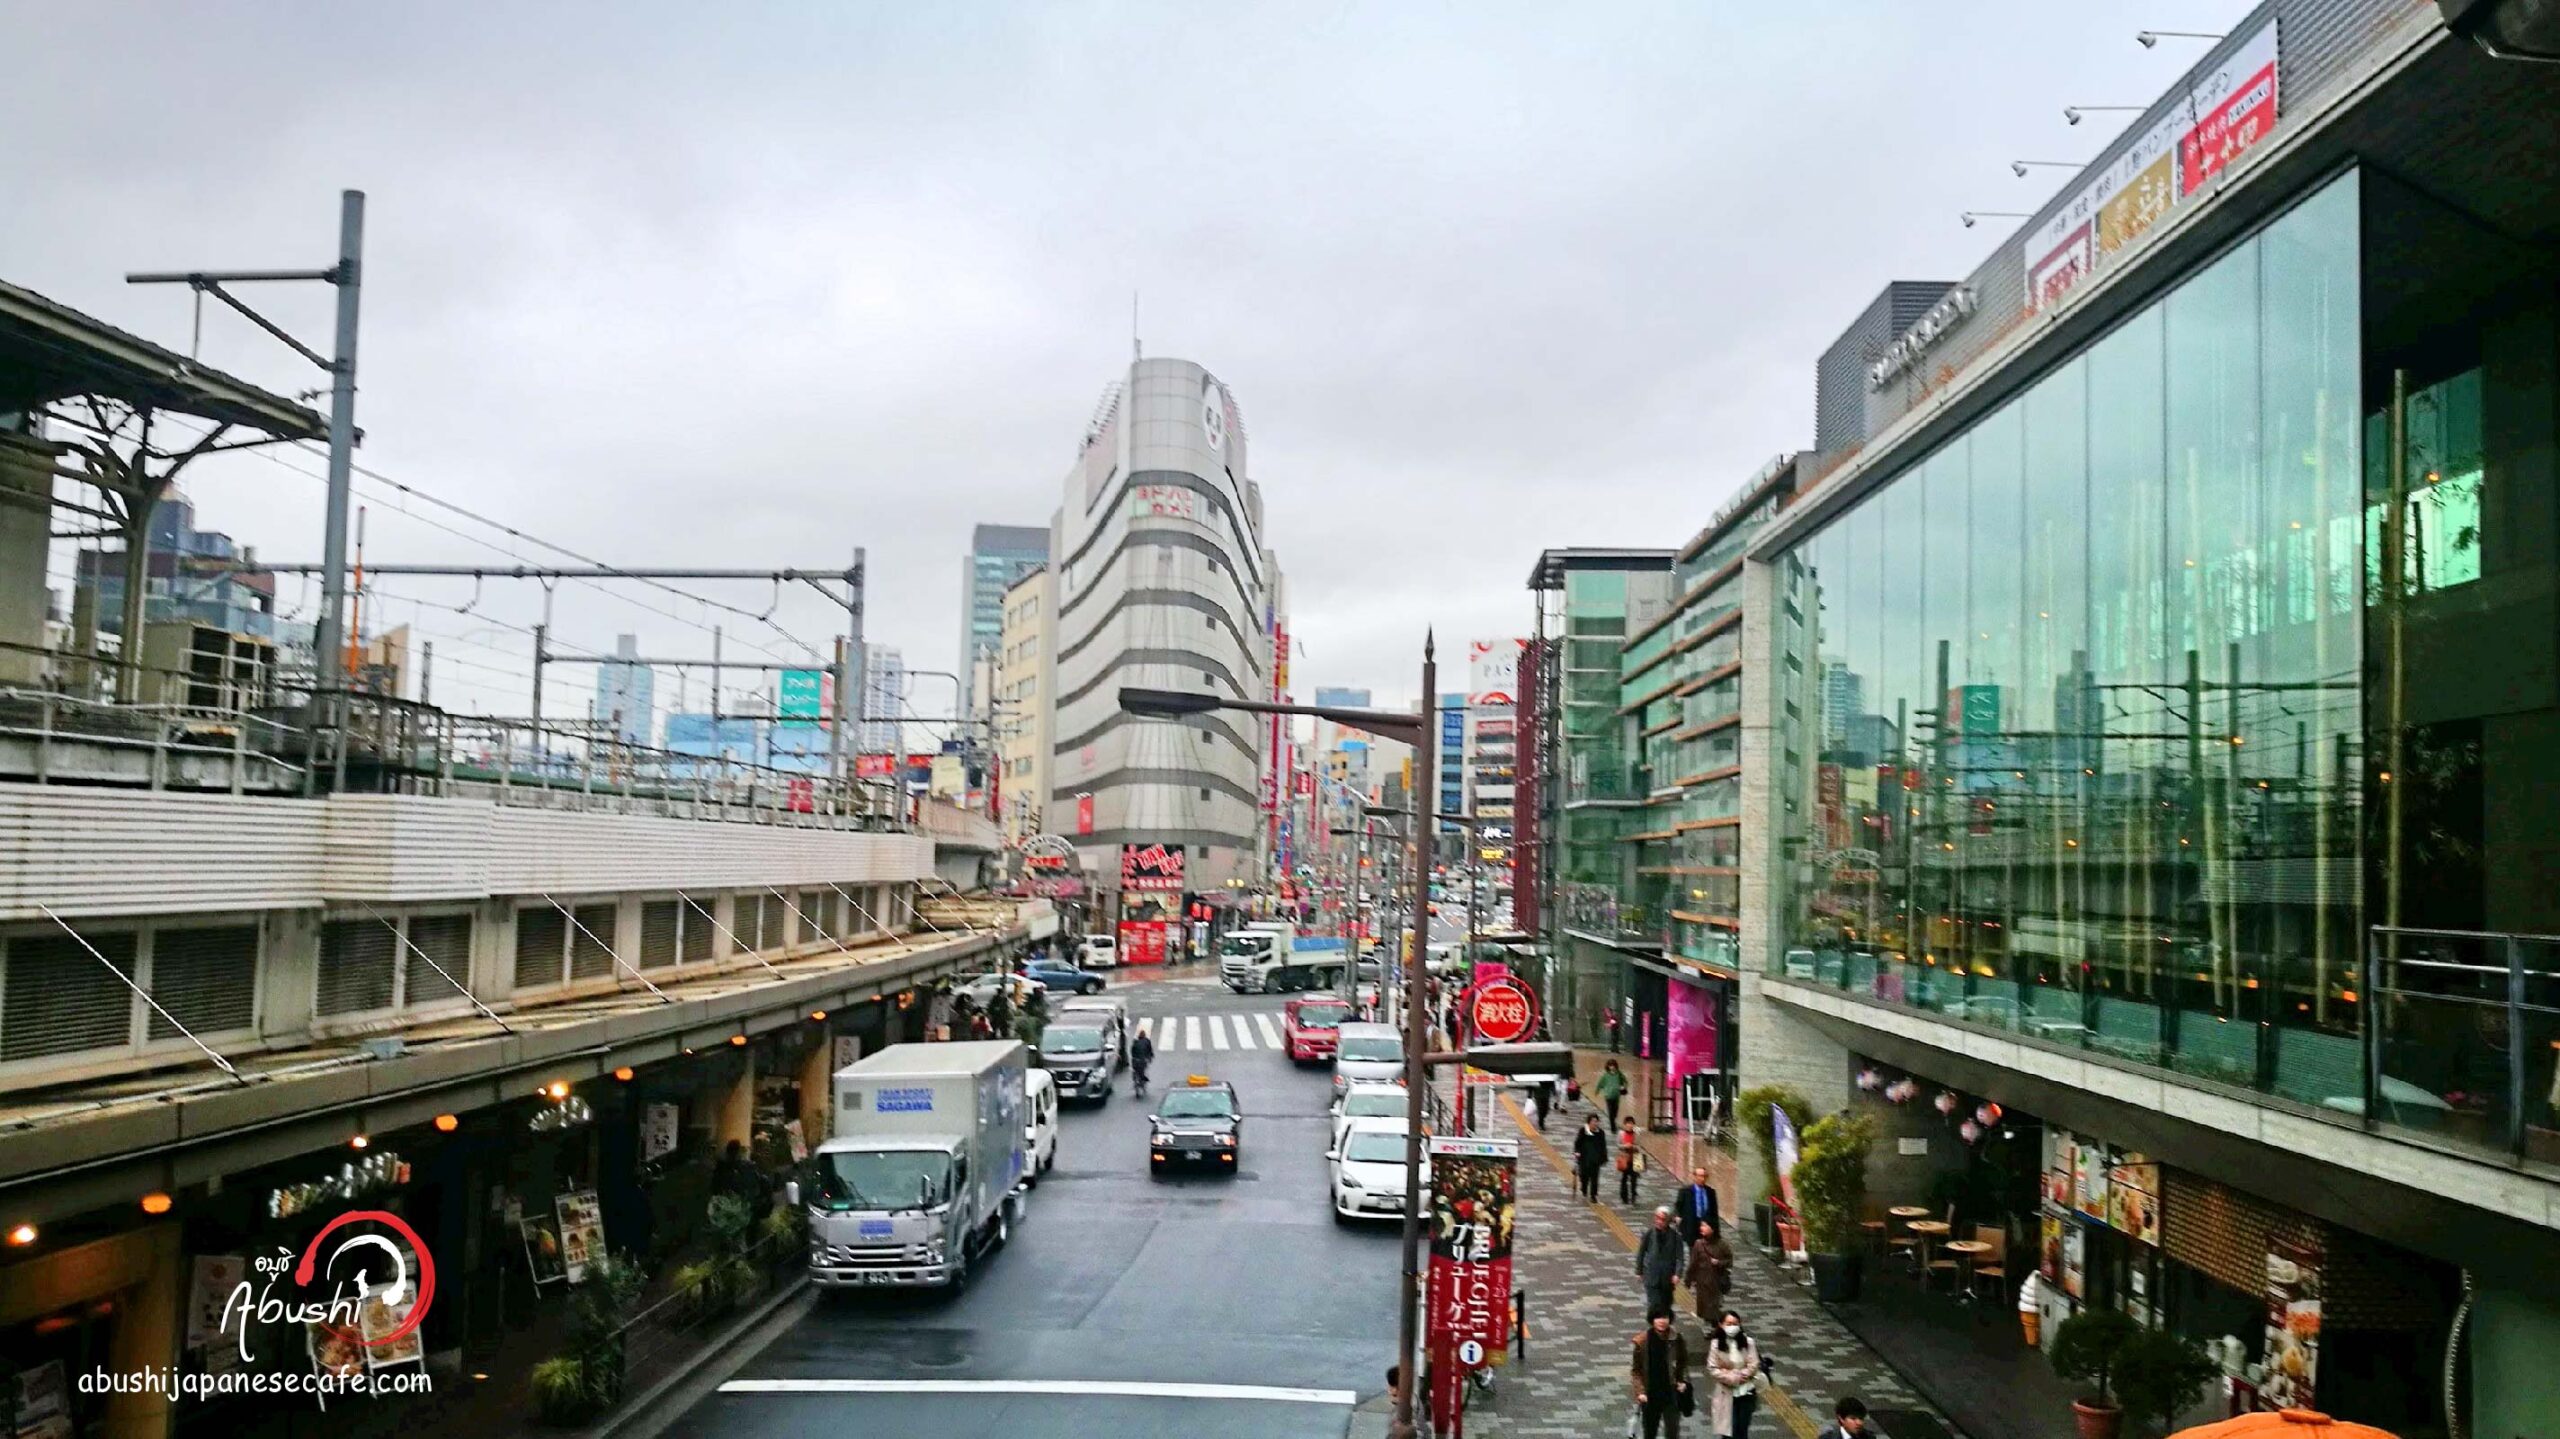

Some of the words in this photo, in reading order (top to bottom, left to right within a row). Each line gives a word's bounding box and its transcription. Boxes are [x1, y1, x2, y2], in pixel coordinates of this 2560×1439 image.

[1479, 1002, 1525, 1023] 消火栓
[877, 1102, 933, 1112] SAGAWA
